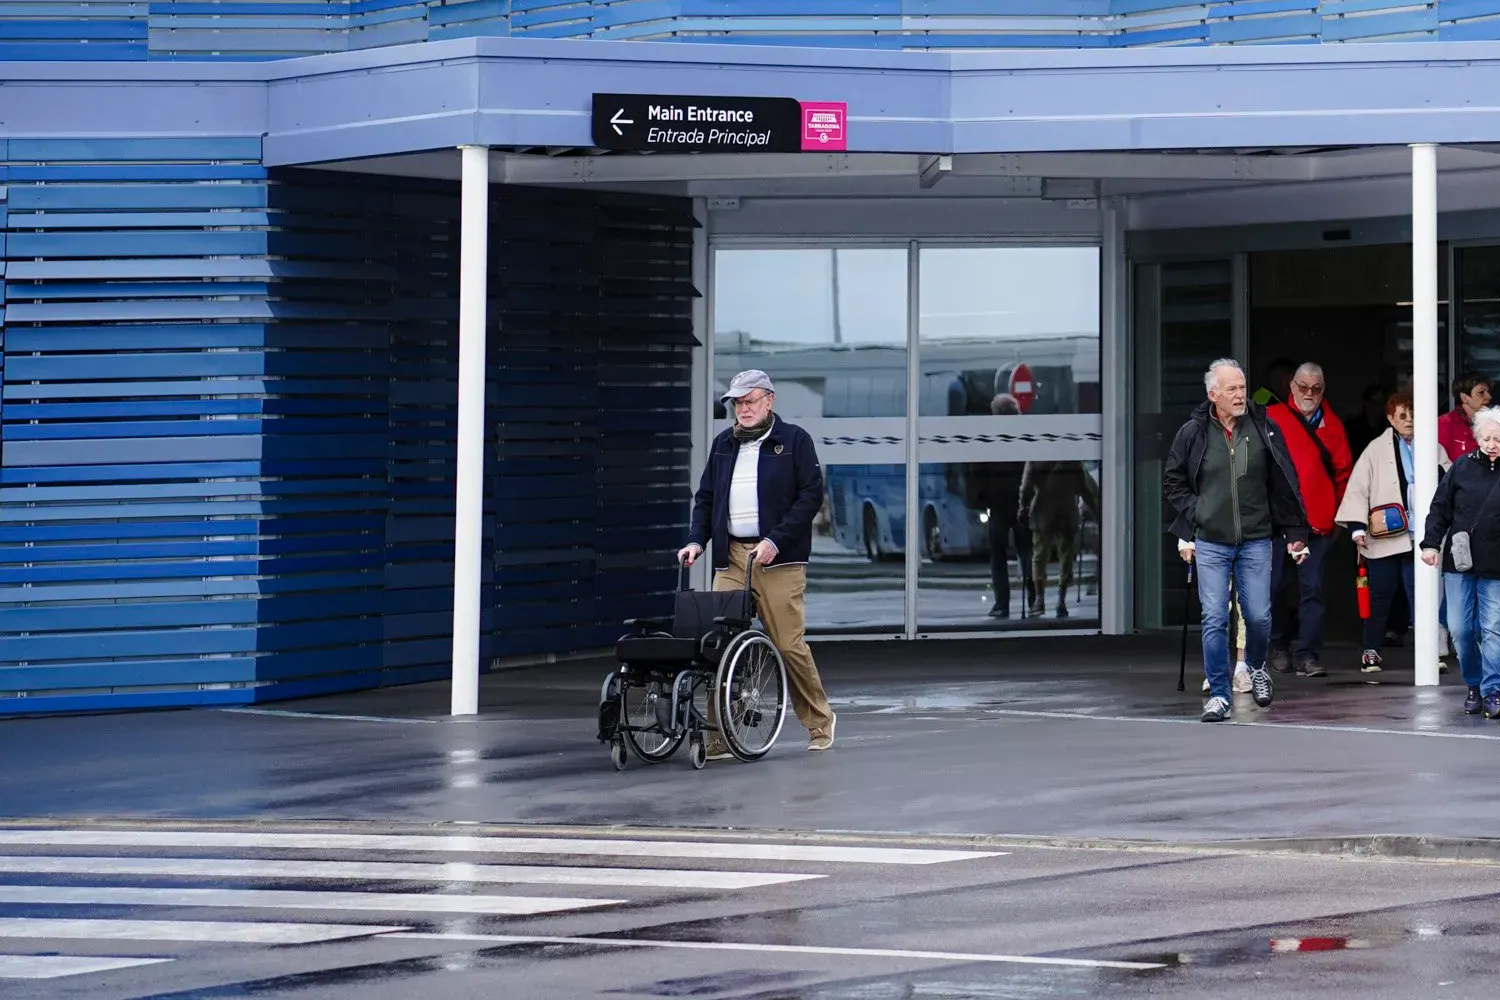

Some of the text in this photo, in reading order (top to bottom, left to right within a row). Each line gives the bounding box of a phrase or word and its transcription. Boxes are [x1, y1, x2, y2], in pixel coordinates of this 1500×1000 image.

[648, 105, 753, 122] Main Entrance
[647, 128, 771, 147] Entrada Principal
